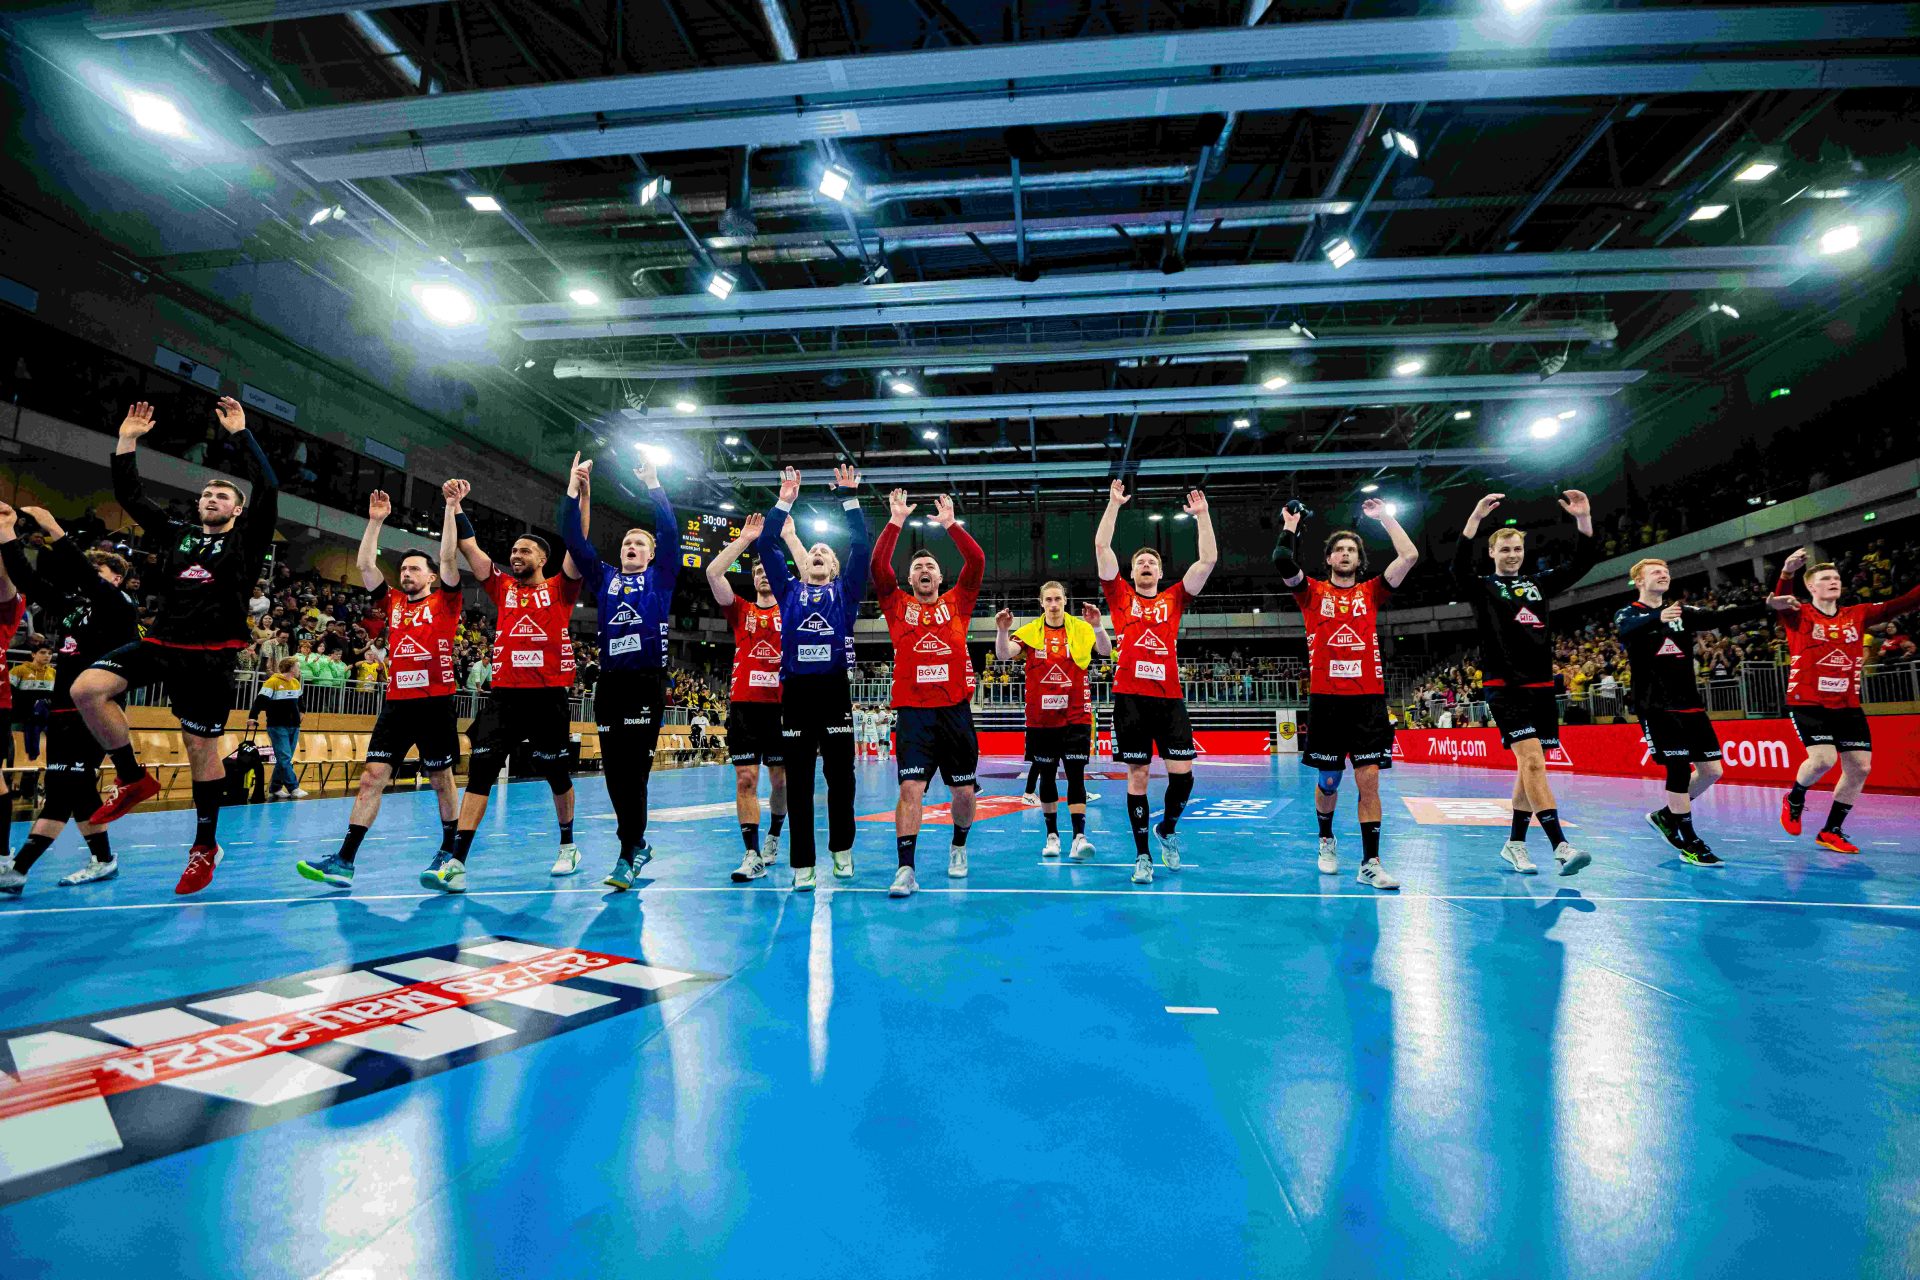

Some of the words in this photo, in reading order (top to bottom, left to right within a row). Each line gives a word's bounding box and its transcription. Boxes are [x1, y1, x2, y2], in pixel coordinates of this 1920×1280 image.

[687, 520, 700, 531] 32
[702, 514, 727, 527] 30:00
[729, 527, 741, 537] 29
[532, 590, 551, 608] 19
[1352, 597, 1367, 617] 25
[412, 606, 433, 627] 24
[1153, 604, 1168, 624] 27
[1337, 633, 1353, 643] WTG
[440, 952, 610, 998] 25/26
[102, 1022, 309, 1082] 2024
